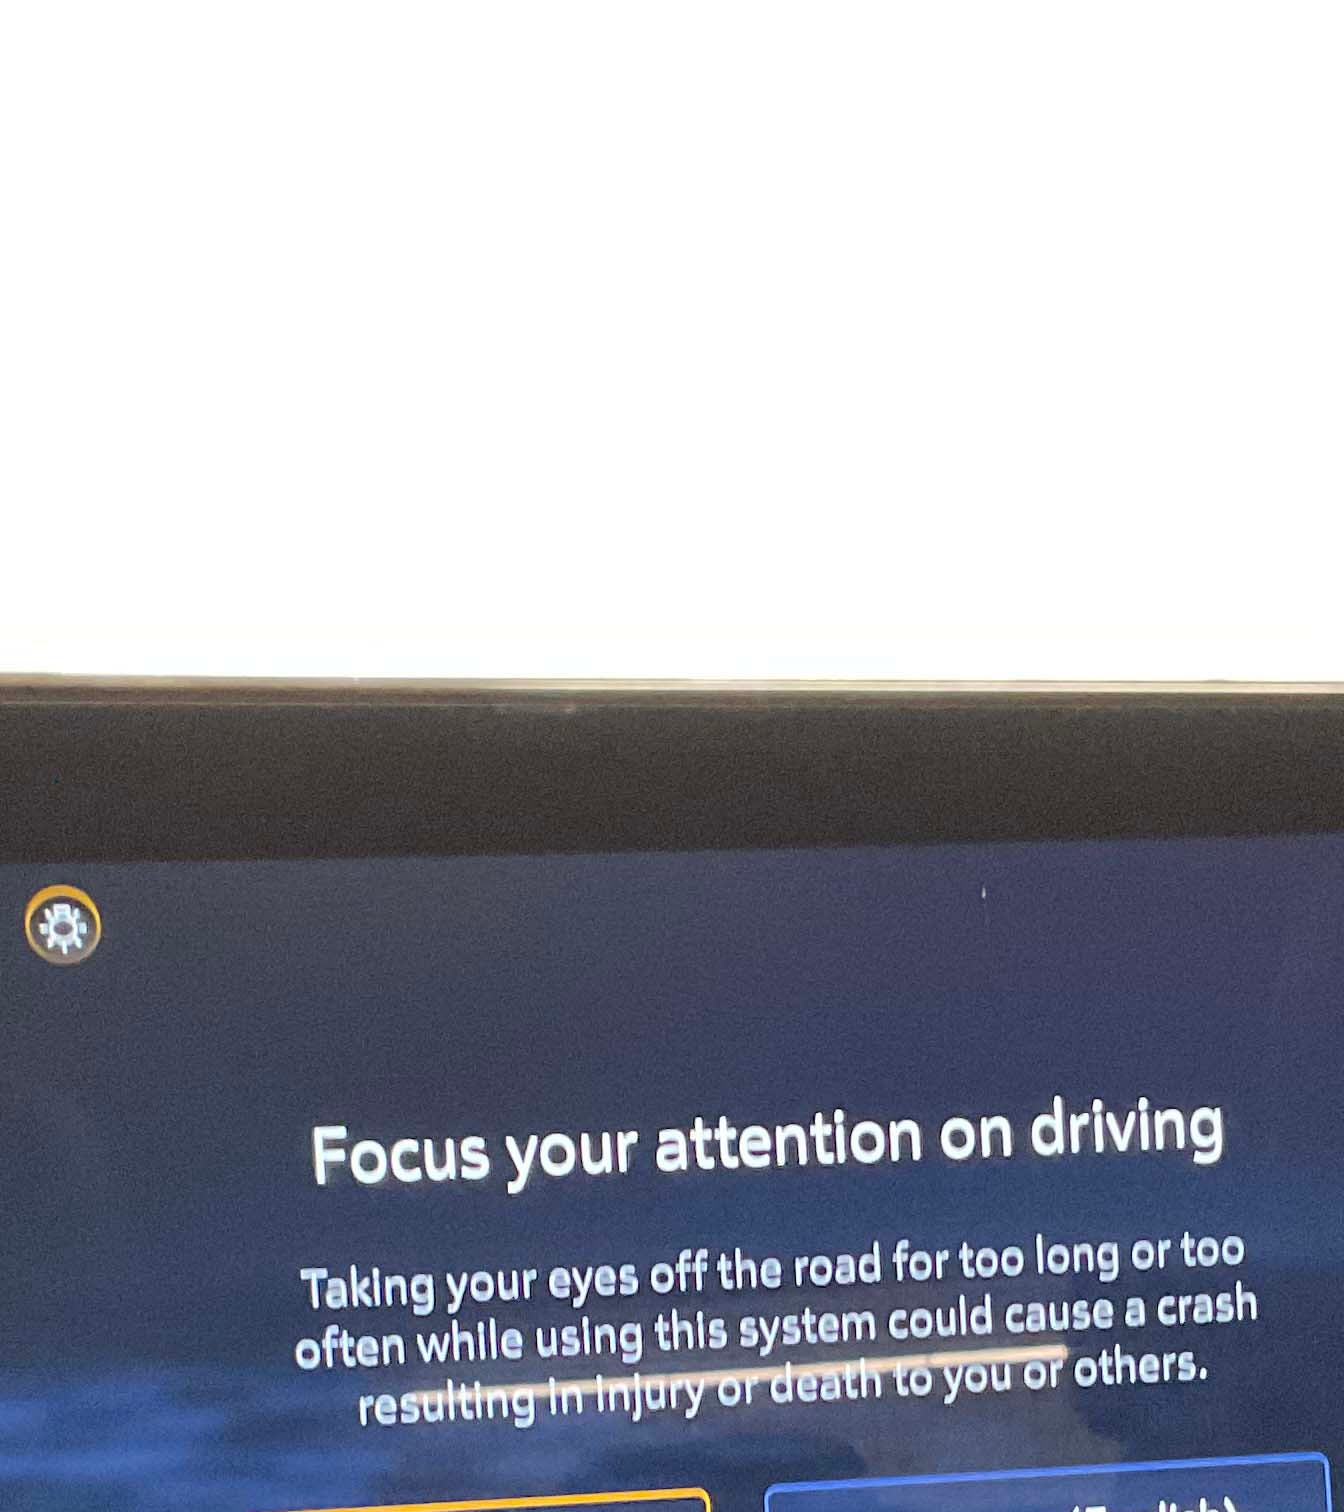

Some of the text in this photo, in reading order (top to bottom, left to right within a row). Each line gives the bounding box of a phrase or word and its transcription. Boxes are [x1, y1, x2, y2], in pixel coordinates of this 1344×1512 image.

[311, 1095, 1224, 1195] Focus your attention on driving
[299, 1231, 1245, 1316] Taking your eyes off the road for too long or too
[294, 1280, 1258, 1369] often while using this system could cause a crash
[359, 1343, 1208, 1428] resulting in injury or death to you or others.
